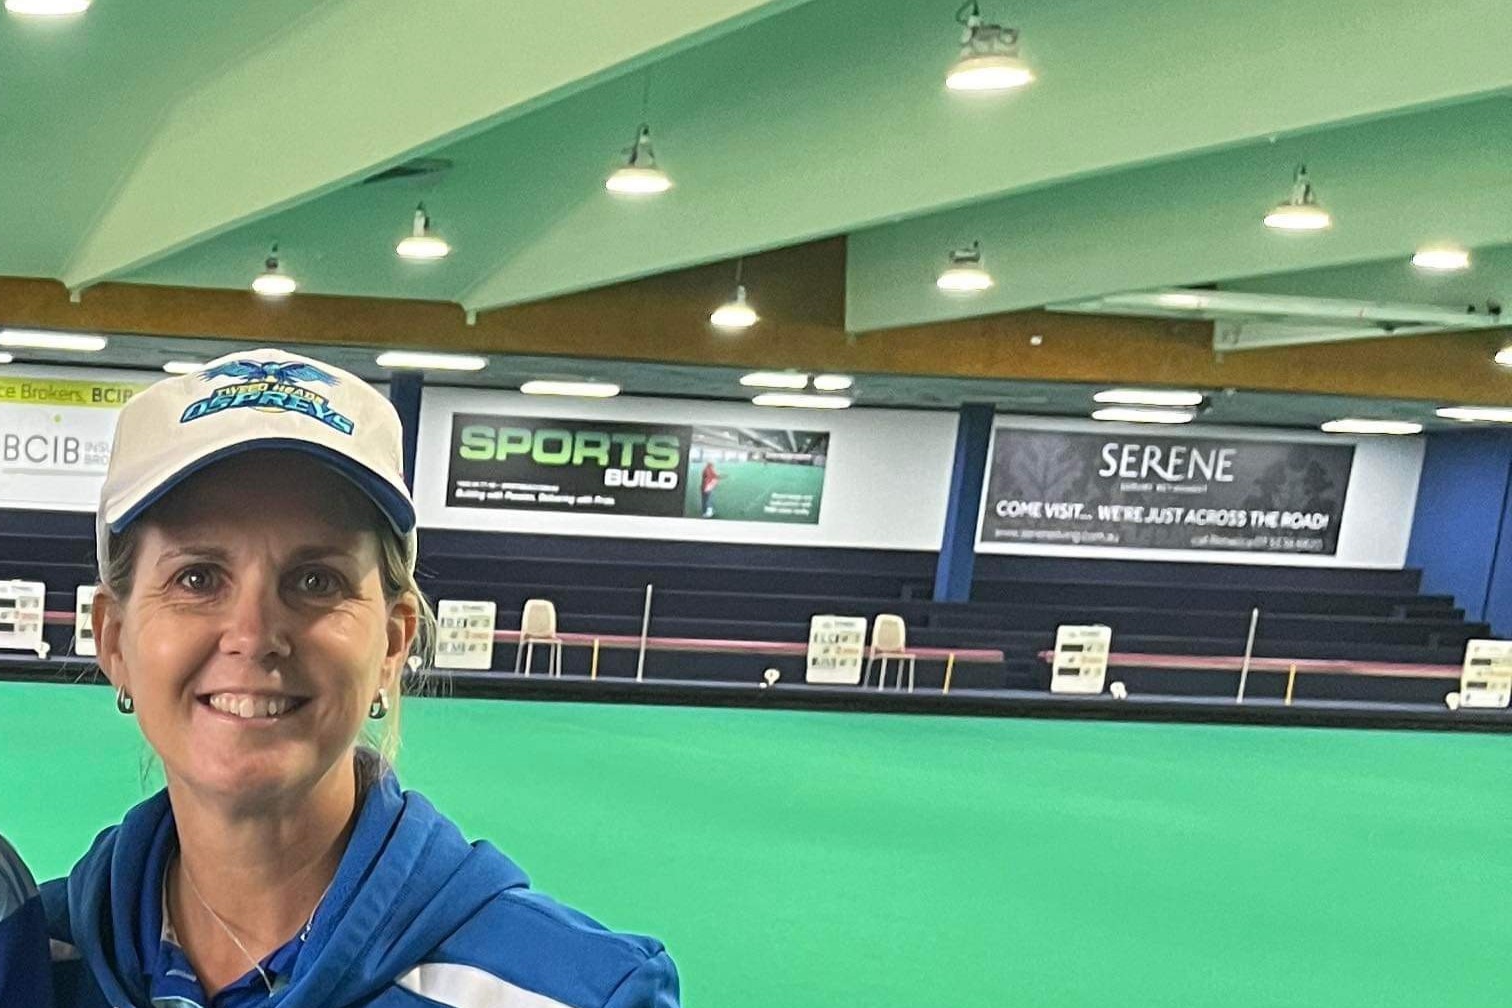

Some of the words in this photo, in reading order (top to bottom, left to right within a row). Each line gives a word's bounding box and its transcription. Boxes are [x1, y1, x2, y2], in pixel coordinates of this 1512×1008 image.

[216, 383, 268, 398] TWEED
[179, 391, 354, 435] OSPREYS
[4, 433, 80, 464] BCIB
[459, 425, 680, 469] SPORTS
[1099, 442, 1237, 482] SERENE
[604, 468, 678, 489] BUILD
[996, 500, 1043, 518] COME
[1144, 507, 1185, 524] JUST
[1184, 508, 1247, 528] ACROSS
[1249, 510, 1280, 529] THE
